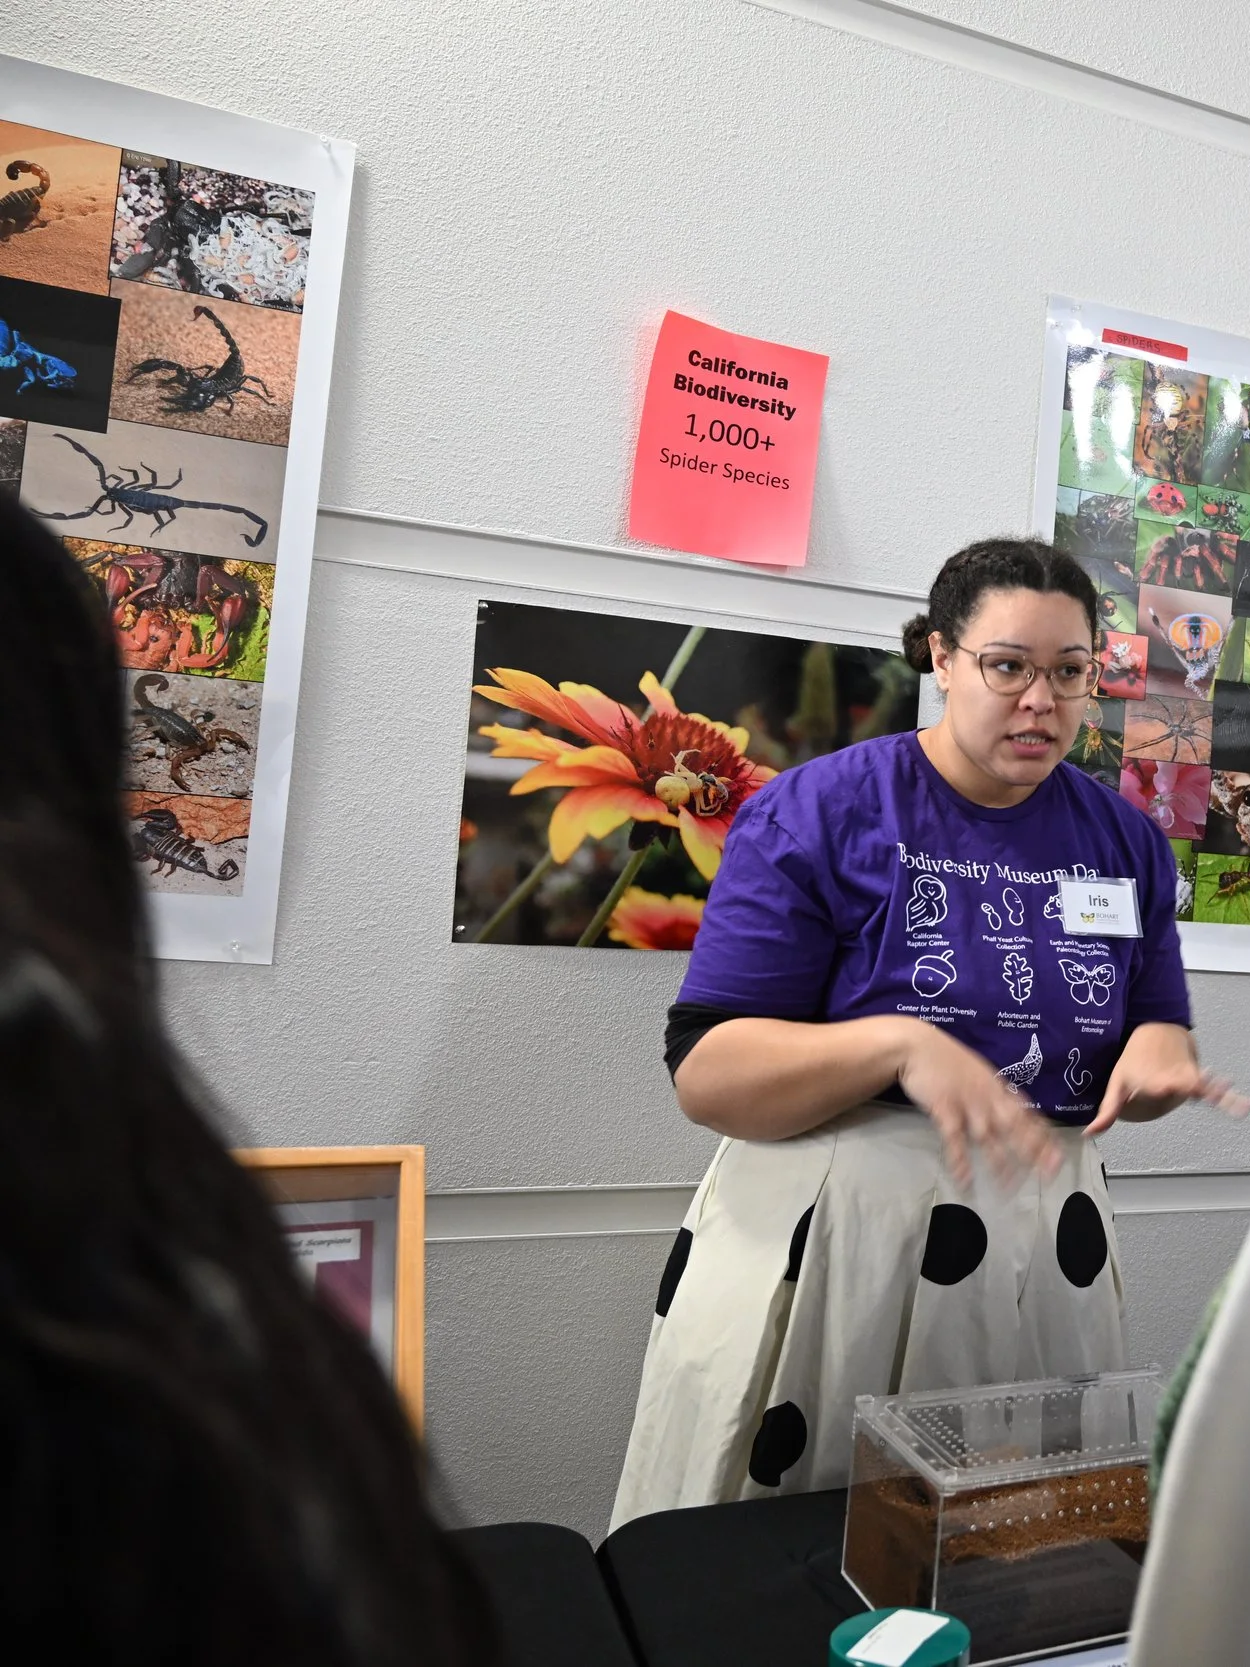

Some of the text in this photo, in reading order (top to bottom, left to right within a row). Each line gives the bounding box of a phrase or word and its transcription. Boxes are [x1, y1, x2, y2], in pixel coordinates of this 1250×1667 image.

[688, 350, 788, 390] California
[673, 373, 796, 421] Biodiversity
[684, 413, 776, 451] 1,000+
[659, 448, 790, 490] Spider Species
[993, 862, 1069, 884] Museum
[1071, 863, 1100, 882] Da
[1088, 895, 1109, 907] Iris
[1096, 912, 1119, 920] BOHART
[897, 1003, 978, 1017] Center for Plant Diversity
[1030, 1012, 1041, 1020] and
[920, 1014, 955, 1023] Herbarium
[997, 1020, 1039, 1029] Public Garden
